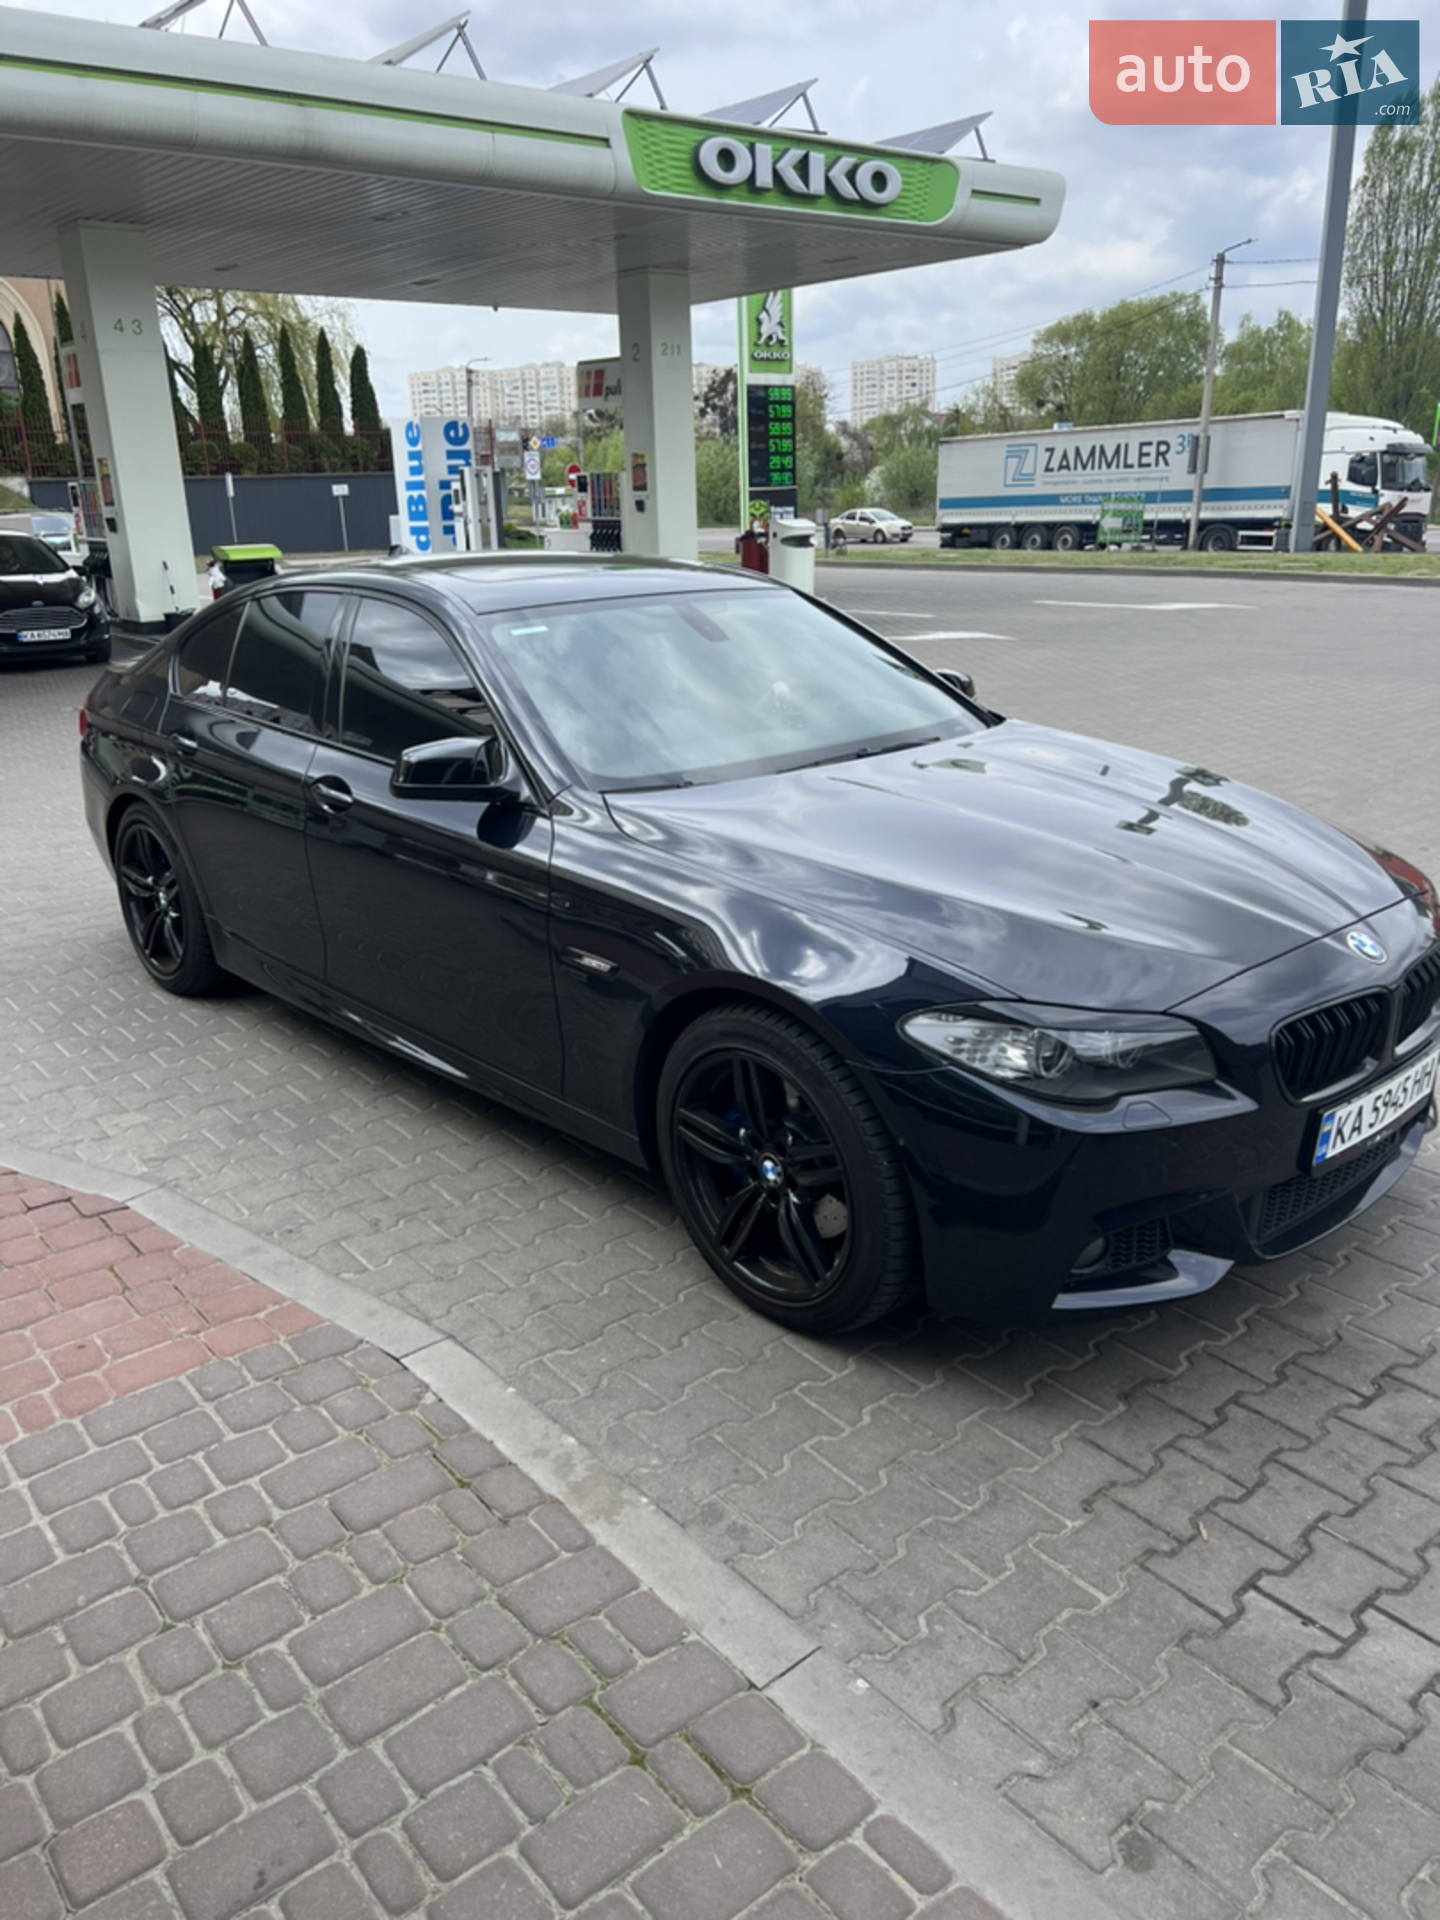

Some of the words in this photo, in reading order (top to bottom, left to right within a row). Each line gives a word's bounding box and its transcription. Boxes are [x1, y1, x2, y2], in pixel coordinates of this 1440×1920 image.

[697, 136, 903, 206] OKKO
[632, 343, 640, 361] 2
[753, 351, 791, 360] OKKO
[1043, 440, 1171, 473] ZAMMLER
[1332, 1105, 1363, 1149] KA
